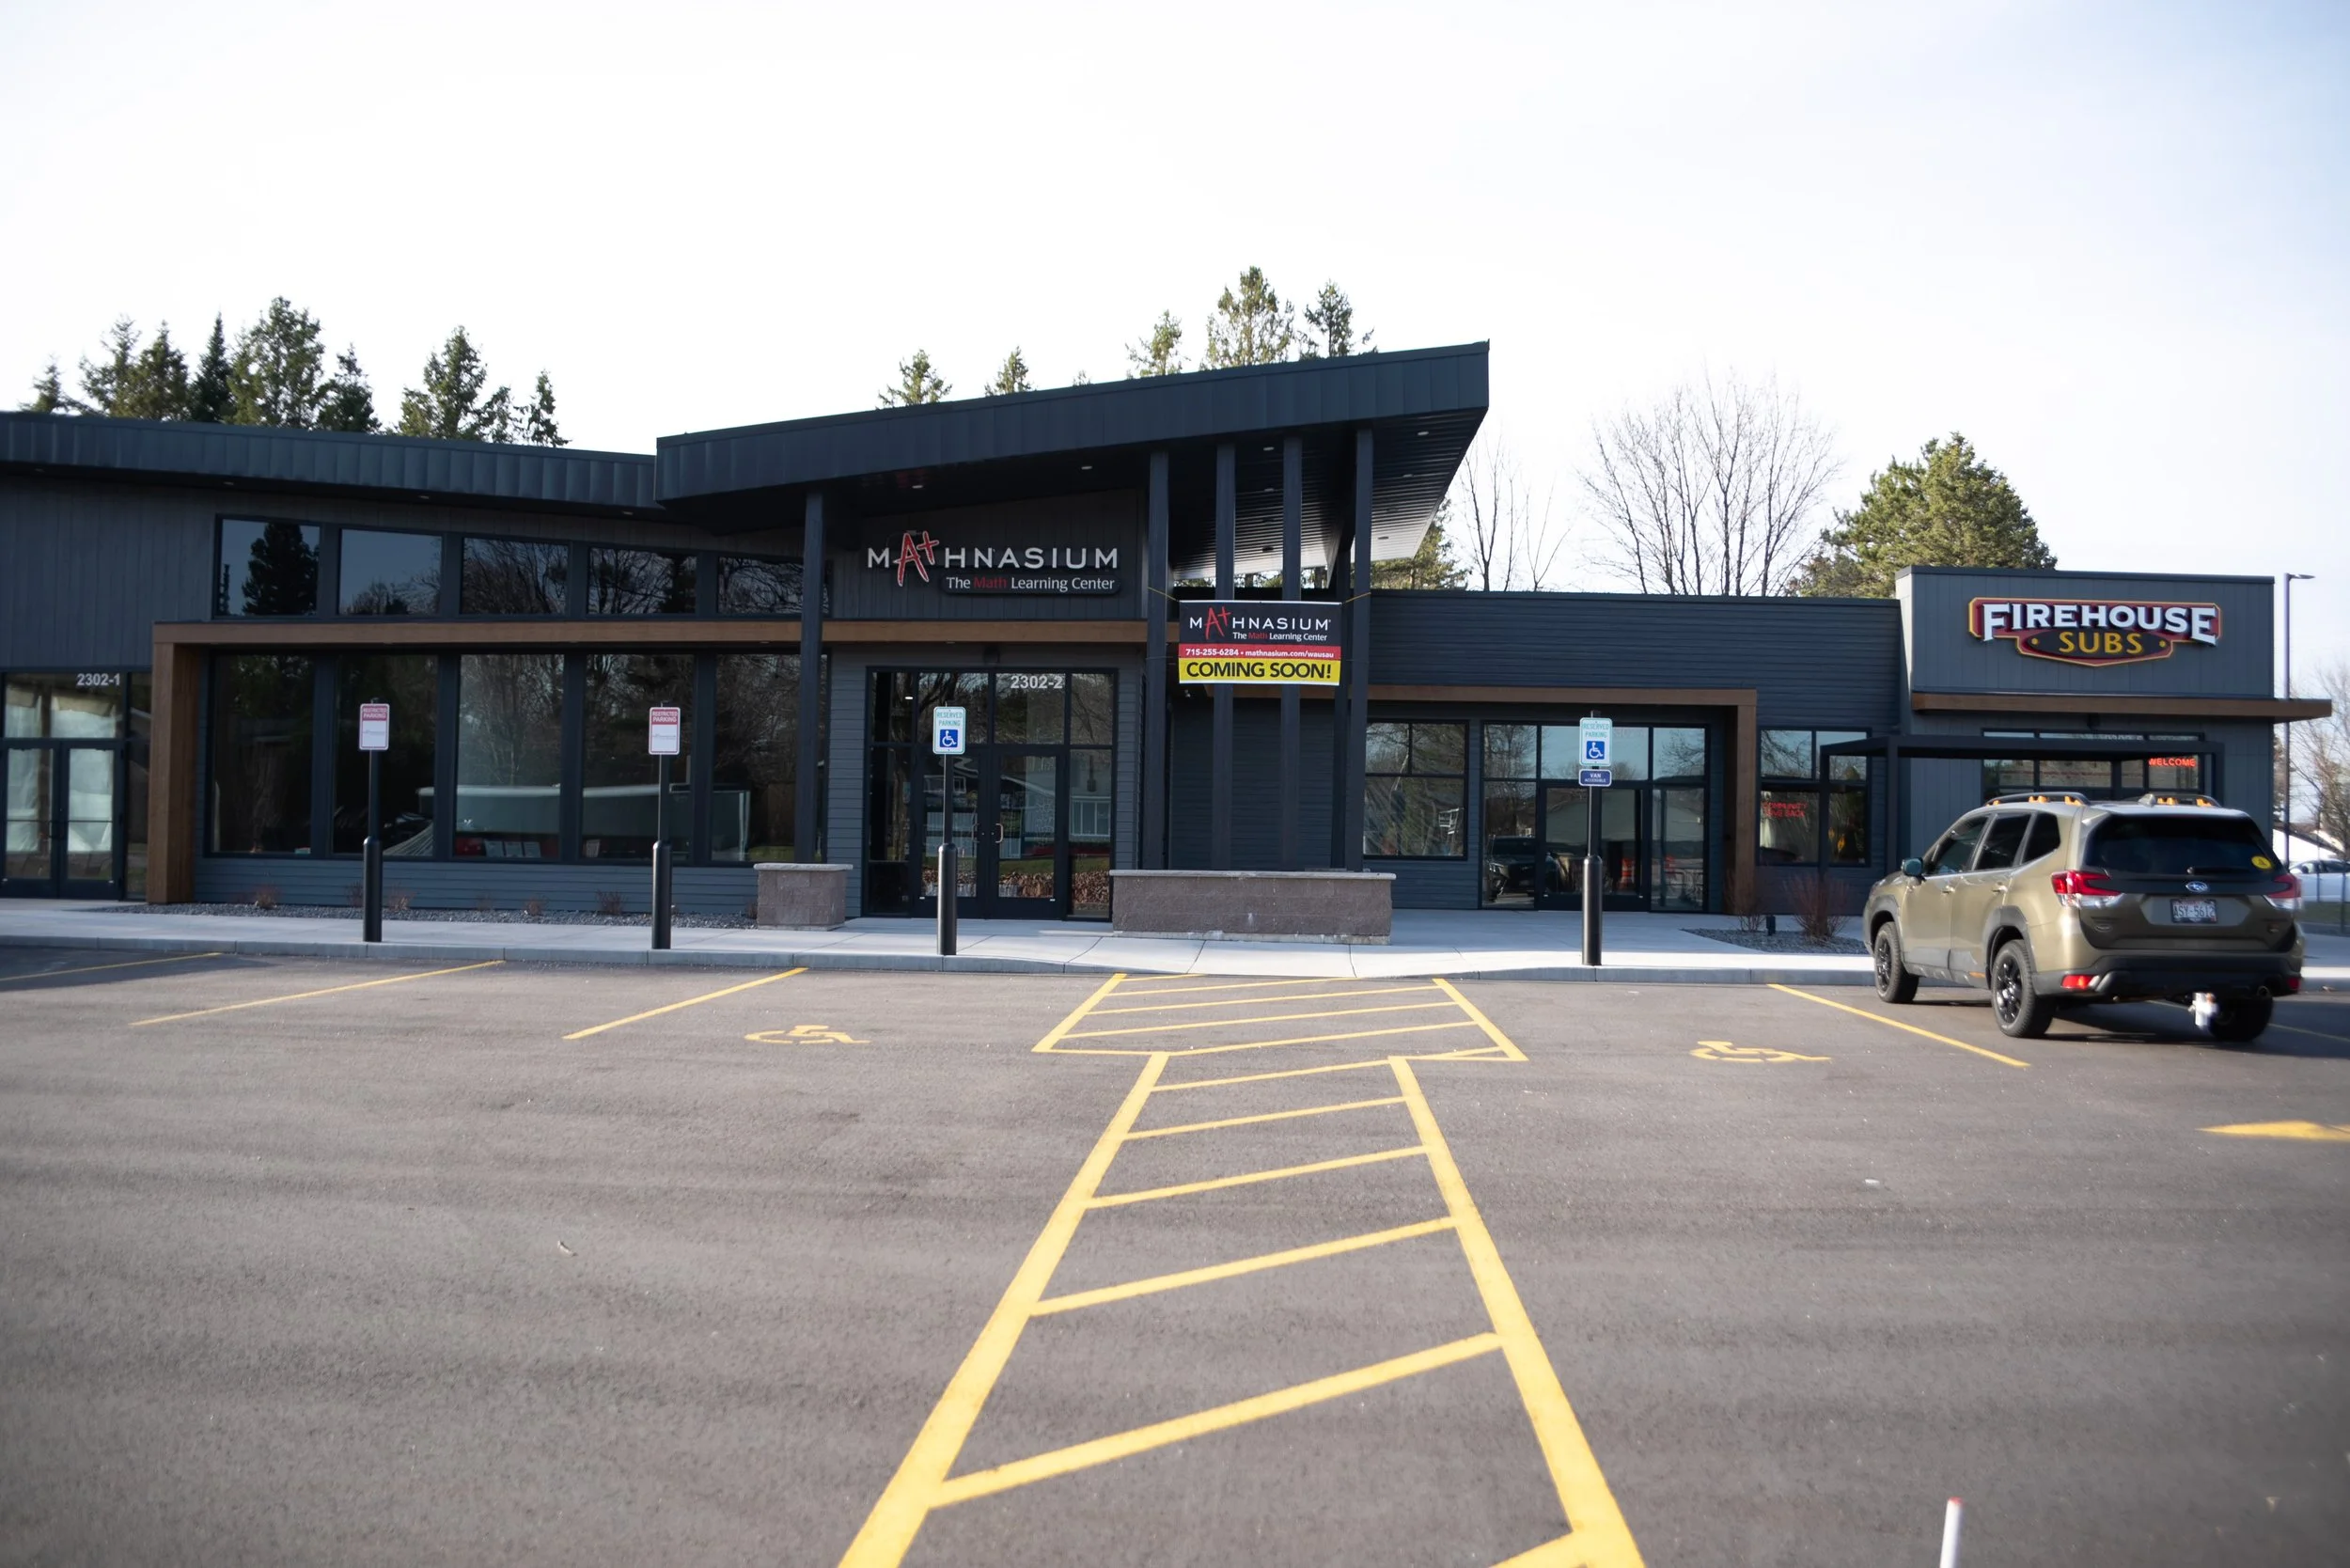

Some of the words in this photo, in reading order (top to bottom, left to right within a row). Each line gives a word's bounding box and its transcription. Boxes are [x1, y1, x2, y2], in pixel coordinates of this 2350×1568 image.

[946, 576, 971, 589] The
[974, 576, 1008, 589] Math
[1011, 576, 1069, 593] Learning
[1072, 576, 1115, 590] Center
[1982, 602, 2217, 647] FIREHOUSE
[1232, 632, 1247, 640] The
[1248, 632, 1268, 640] Math
[1269, 632, 1303, 642] Learning
[1303, 633, 1328, 641] Center
[2059, 631, 2143, 654] SUBS
[1185, 648, 1239, 656] 715-255-6284
[1246, 650, 1334, 658] mathnasium.com/wausau
[1186, 662, 1265, 677] COMING
[1270, 662, 1332, 679] SOON!
[76, 673, 121, 686] 2302-1
[1010, 675, 1063, 689] 2302-2
[2148, 757, 2197, 768] WELCOME
